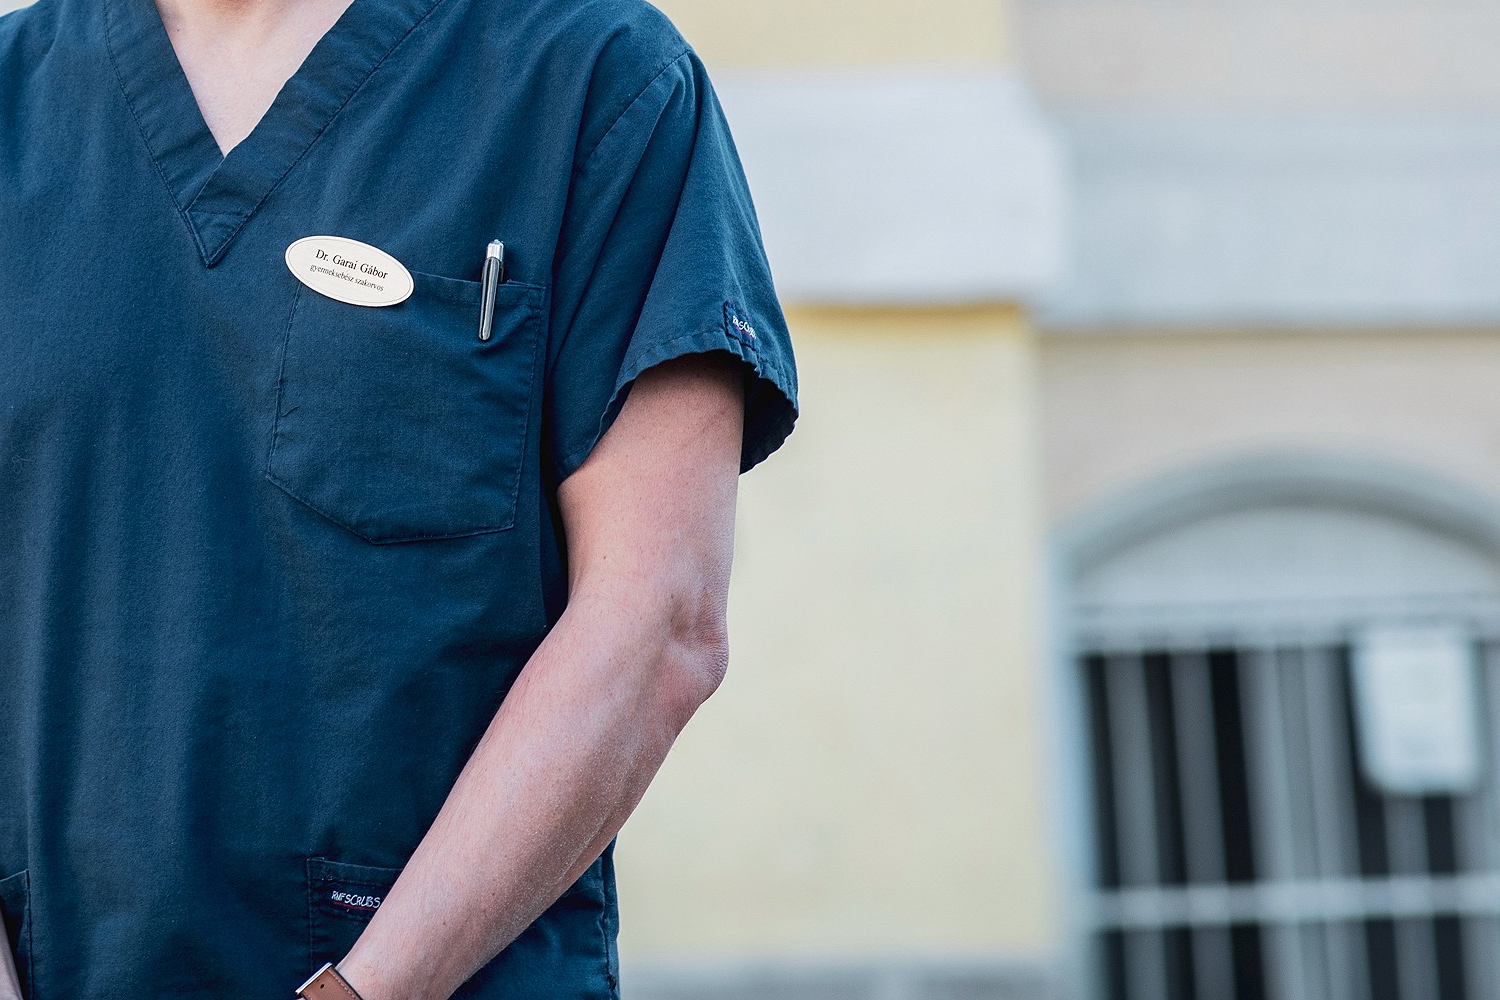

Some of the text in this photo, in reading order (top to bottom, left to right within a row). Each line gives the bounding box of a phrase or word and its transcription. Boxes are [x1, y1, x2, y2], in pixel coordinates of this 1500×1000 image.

[309, 264, 384, 291] gyermeksebész szakorvos
[315, 249, 388, 279] Dr. Garai Gábor
